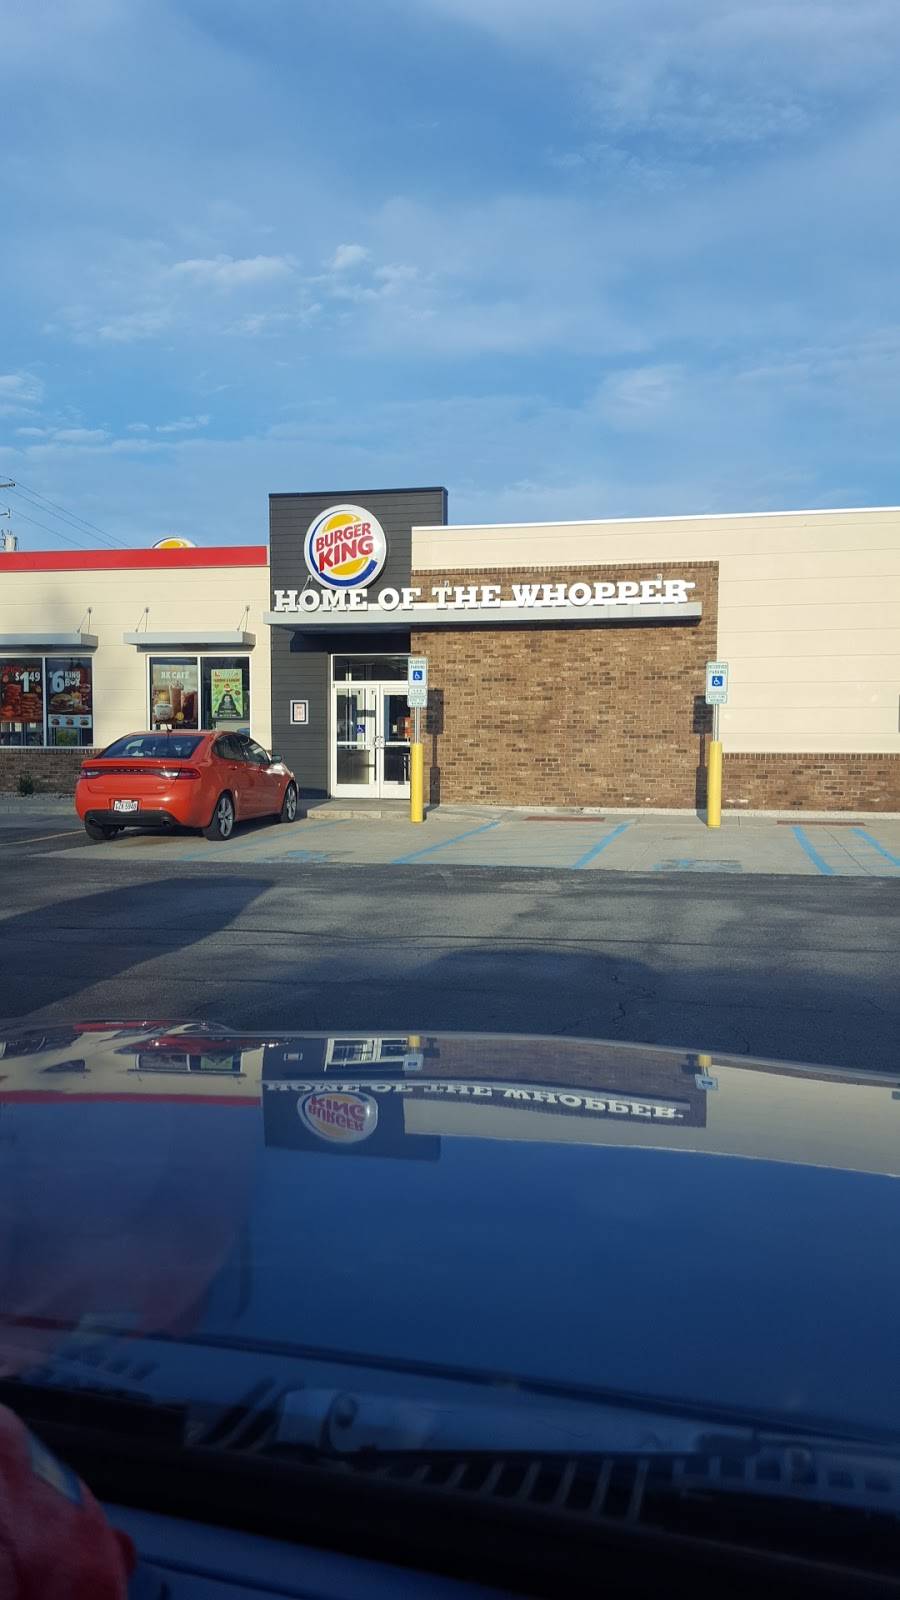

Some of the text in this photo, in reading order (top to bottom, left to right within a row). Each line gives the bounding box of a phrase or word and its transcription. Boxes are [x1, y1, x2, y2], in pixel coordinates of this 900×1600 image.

[316, 522, 371, 552] BURGER
[318, 535, 374, 571] KING
[274, 580, 695, 612] HOME OF THE WHOPPER
